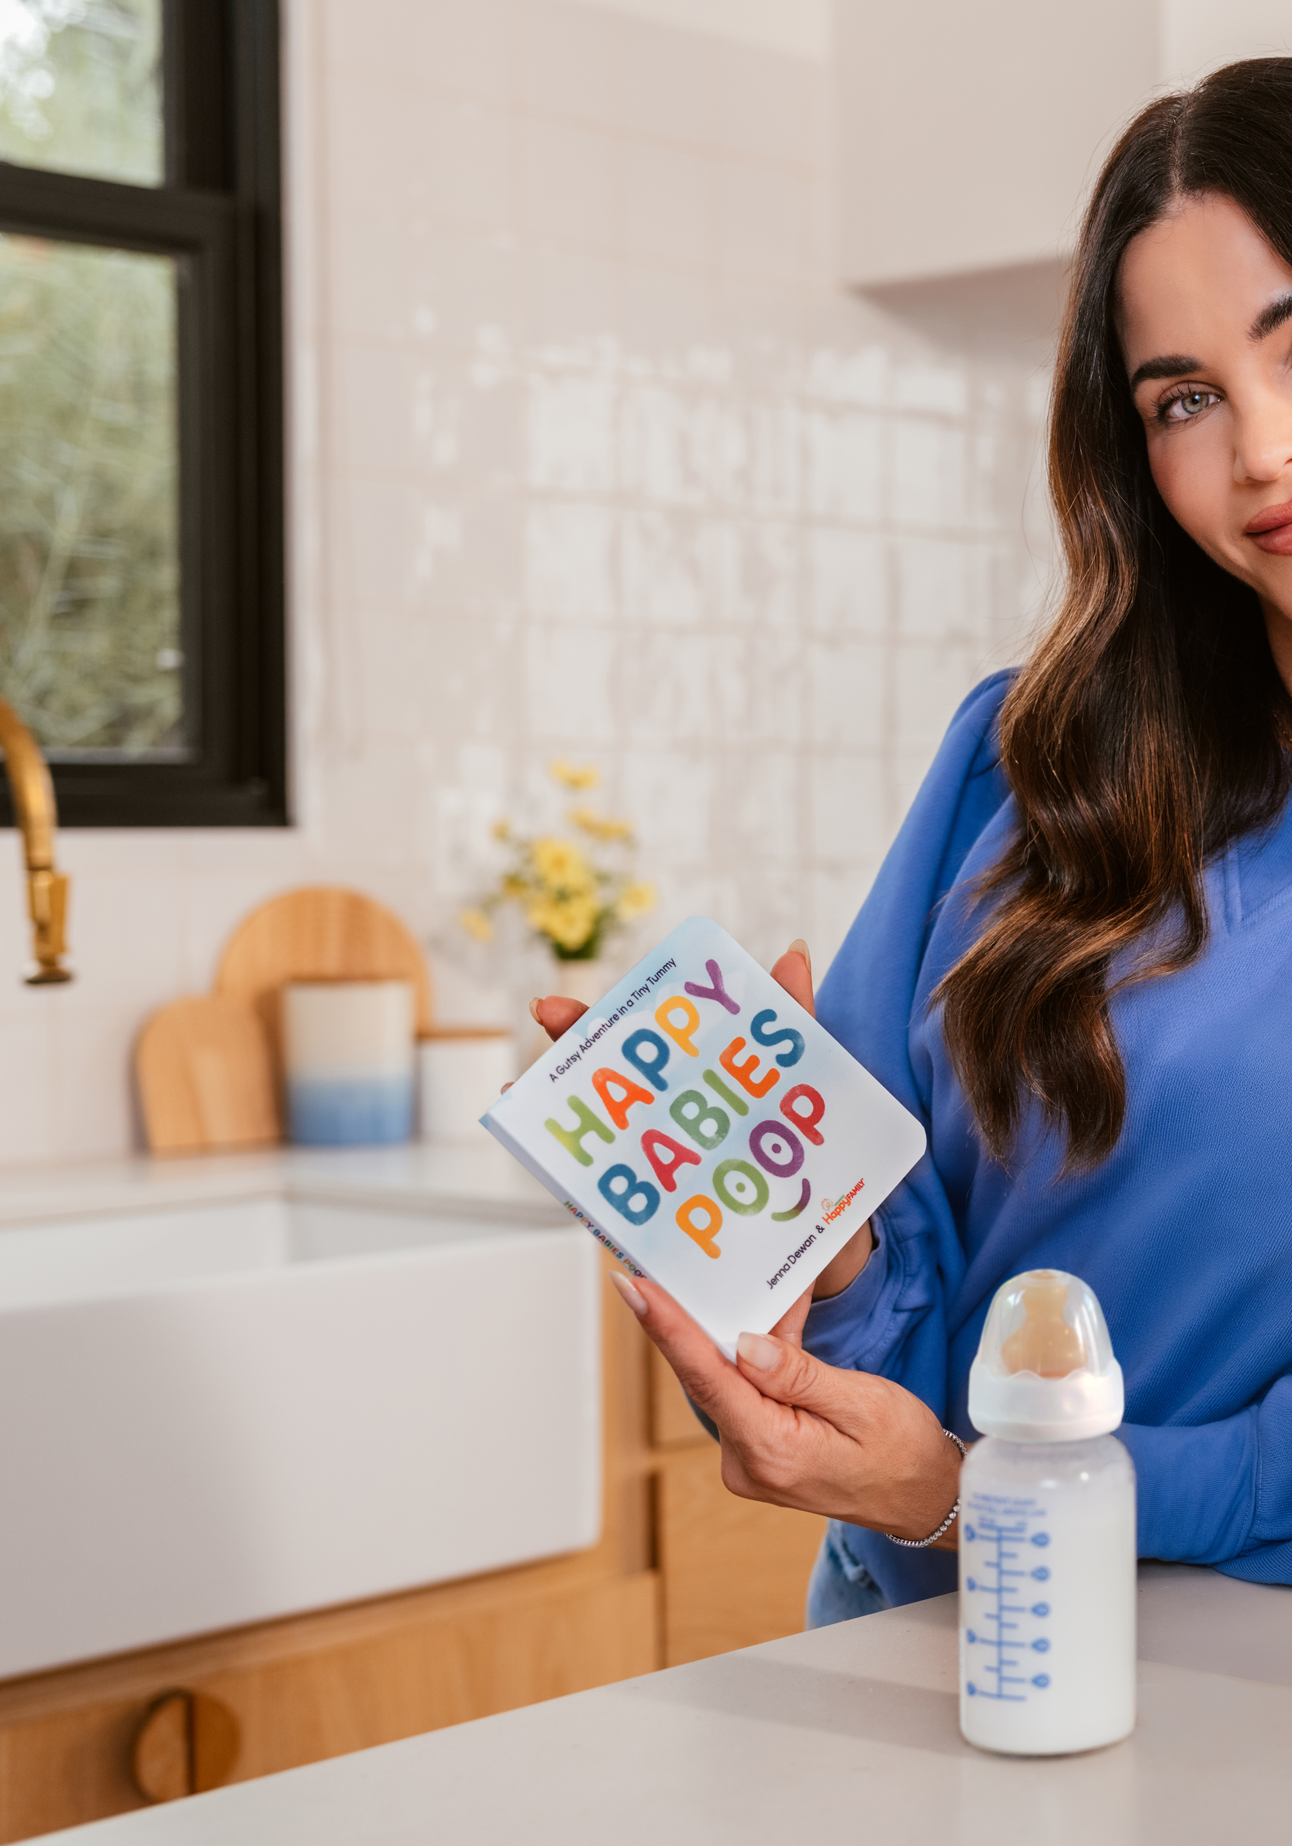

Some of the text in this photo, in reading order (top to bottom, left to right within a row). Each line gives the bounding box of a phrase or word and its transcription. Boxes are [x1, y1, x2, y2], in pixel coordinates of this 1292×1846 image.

[544, 959, 741, 1167] HAPPY
[549, 958, 677, 1083] A Gutsy Adventure in a Tiny Tummy
[597, 1009, 805, 1226] BABIES
[675, 1084, 825, 1259] POOP
[564, 1200, 595, 1228] HAPPY
[593, 1228, 624, 1259] BABIES
[766, 1262, 791, 1290] Jenna
[787, 1234, 817, 1265] Dewan
[815, 1224, 825, 1234] &
